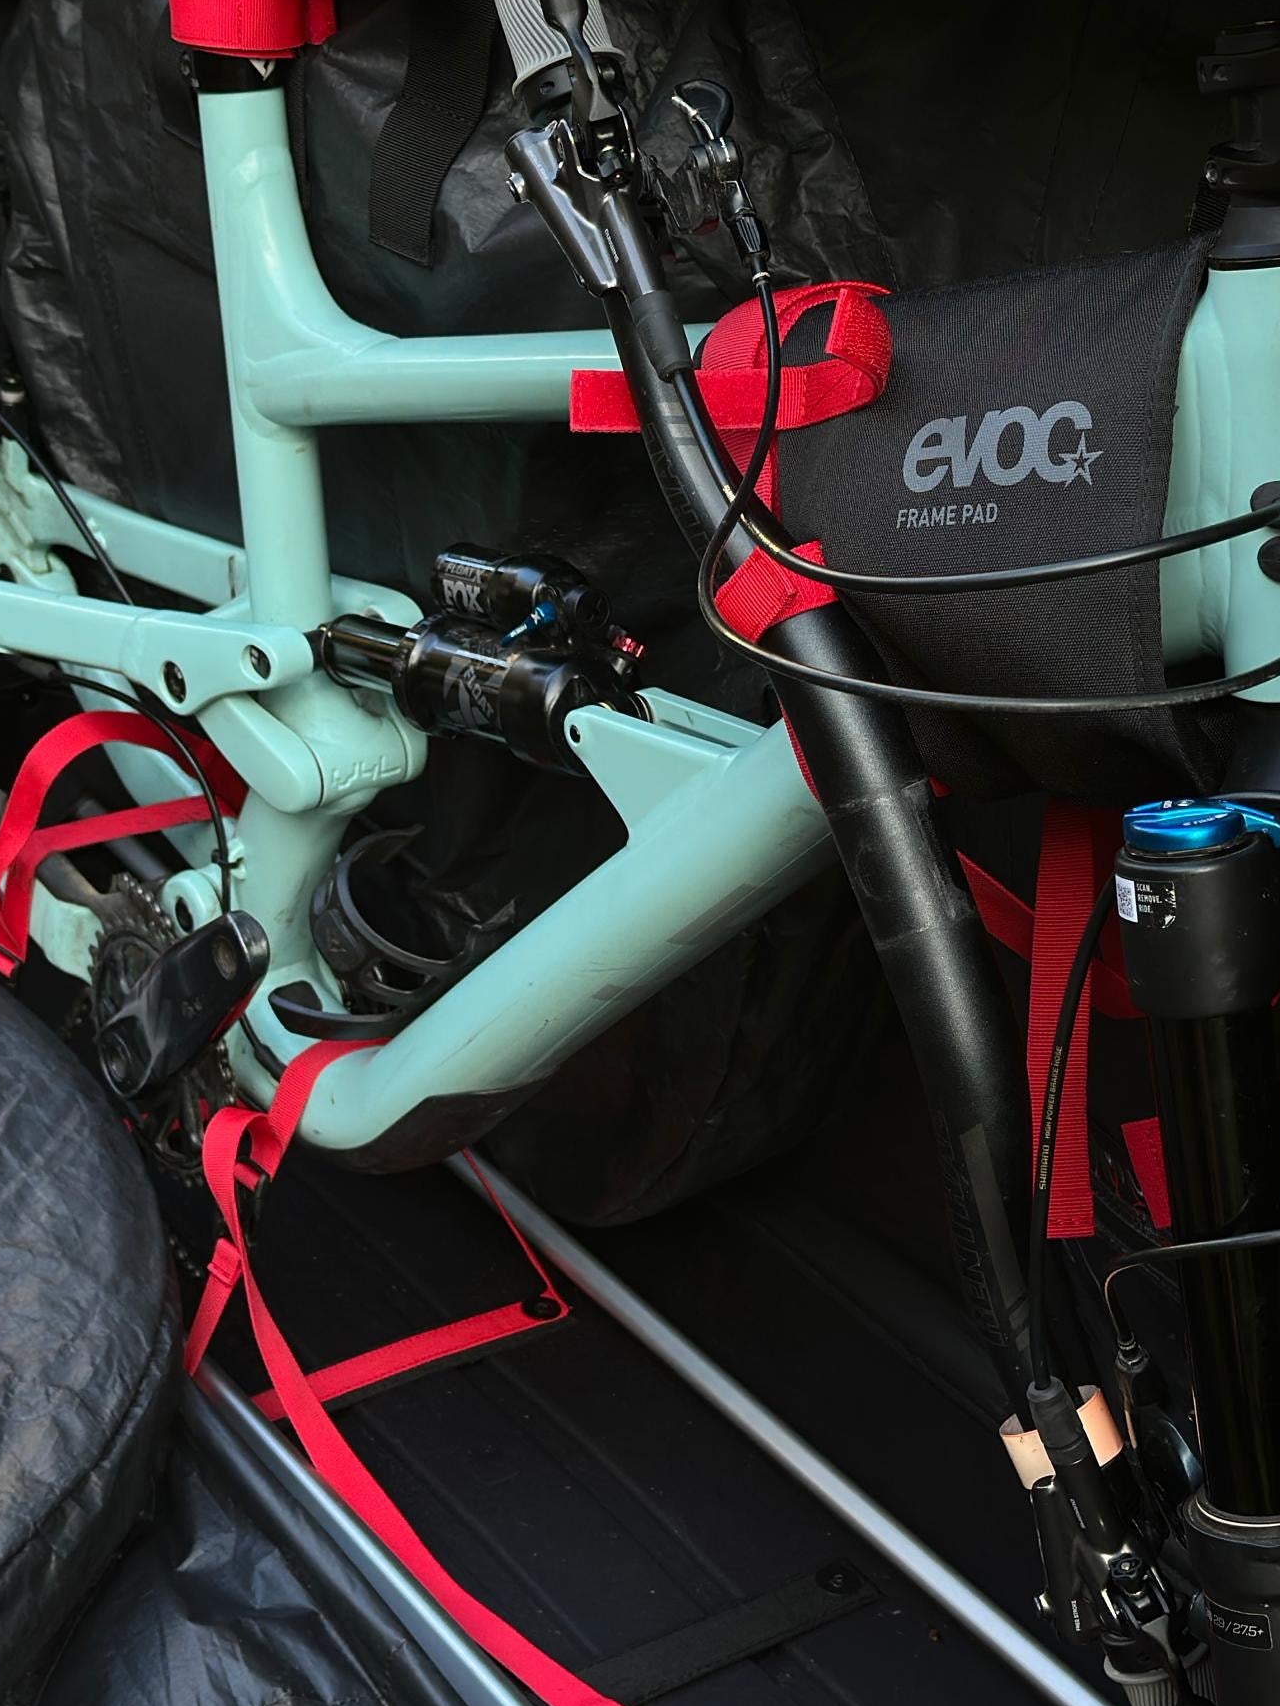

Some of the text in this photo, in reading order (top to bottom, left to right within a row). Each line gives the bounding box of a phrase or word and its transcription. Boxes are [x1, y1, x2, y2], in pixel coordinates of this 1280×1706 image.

[897, 502, 998, 530] FRAME PAD
[442, 580, 484, 614] FOX
[1055, 1045, 1063, 1066] HOSE
[1050, 1066, 1060, 1093] BRAKE
[1046, 1094, 1056, 1121] POWER
[1039, 1144, 1050, 1190] SHIMANO
